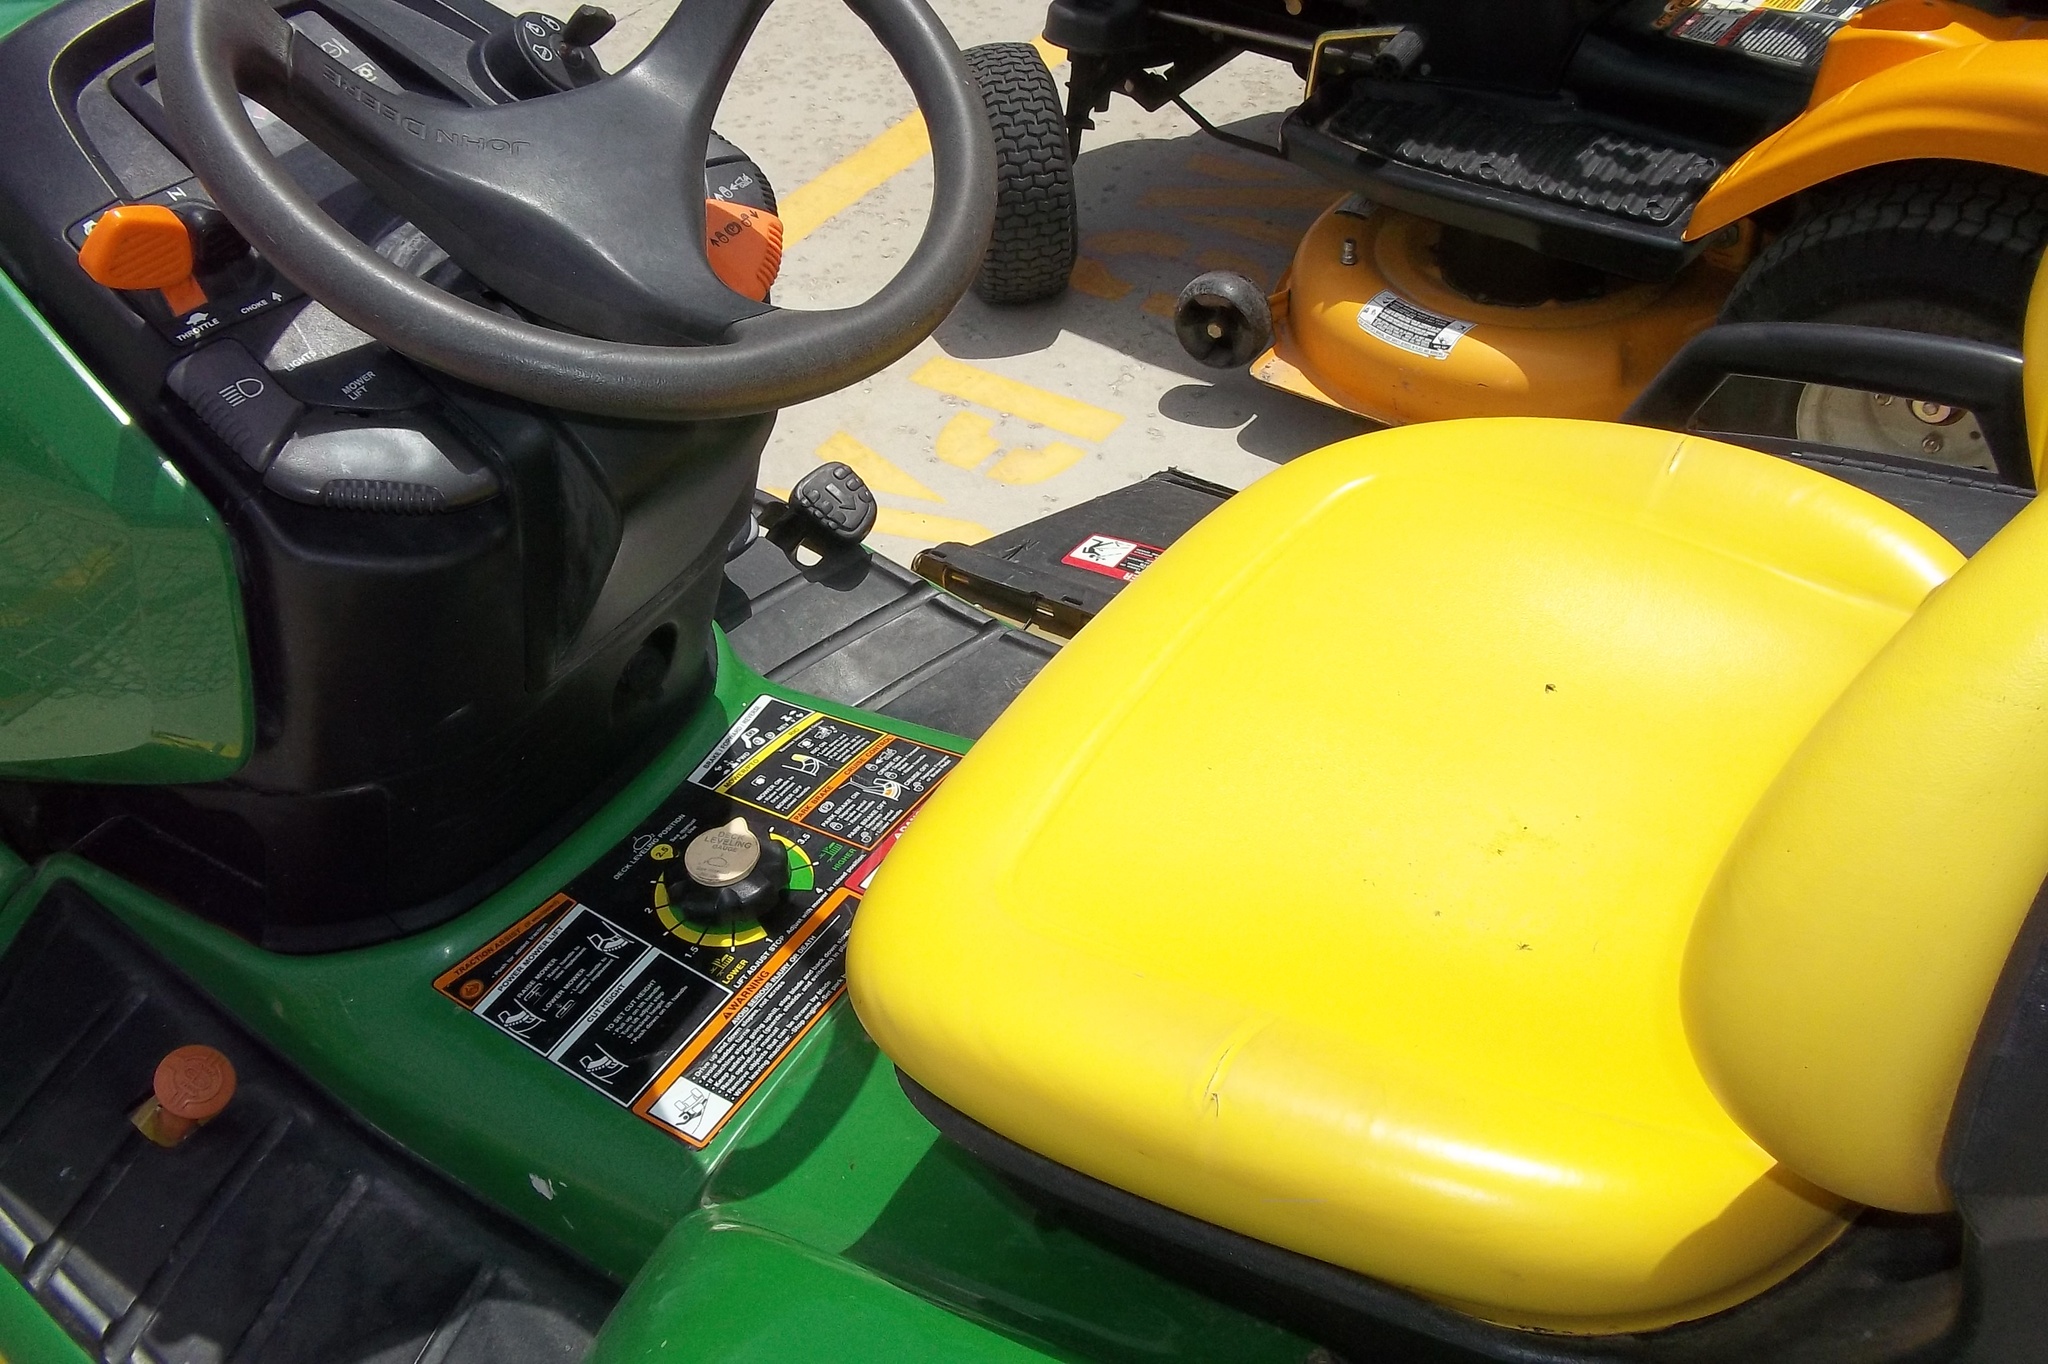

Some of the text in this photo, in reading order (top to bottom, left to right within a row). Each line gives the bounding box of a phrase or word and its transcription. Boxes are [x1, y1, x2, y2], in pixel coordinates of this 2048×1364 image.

[323, 65, 530, 155] JOHN DEERE
[240, 299, 269, 315] CHOKE
[176, 317, 220, 343] THROTTLE
[284, 350, 317, 373] LIGHTS
[341, 370, 377, 396] MOWER
[348, 384, 369, 401] LIFT
[702, 751, 721, 768] BRAKE
[735, 751, 751, 762] FWD
[842, 757, 867, 775] CRUISE
[864, 735, 894, 757] CONTROL
[755, 784, 776, 801] MOWER
[774, 784, 804, 809] MOWER OFF
[793, 785, 834, 820] PARK BRAKE
[819, 813, 837, 827] PARK
[833, 798, 853, 814] BRAKE
[846, 800, 888, 838] PARK BRAKE OFF
[612, 813, 686, 879] DECK LEVELING POSITION
[704, 835, 752, 849] LEVELING
[718, 831, 746, 841] DECK
[796, 833, 811, 844] 3.5
[655, 846, 669, 857] 2.5
[831, 848, 856, 870] HIGHER
[815, 886, 824, 894] 4
[453, 927, 522, 975] TRACTION ASSIST
[496, 966, 524, 991] POWER
[522, 940, 549, 966] MOWER
[547, 925, 564, 940] LIFT
[684, 945, 699, 958] 1.5
[732, 935, 786, 988] LIFT ADJUST STOP
[516, 957, 558, 998] RAISE MOWER
[721, 958, 748, 984] LOWER
[730, 935, 816, 1024] AVOID SERIOUS INJURY OR DEATH
[541, 967, 586, 1011] LOWER MOWER
[727, 969, 770, 1011] WARNING
[585, 982, 626, 1023] CUT HEIGHT
[604, 978, 657, 1031] TO SET CUT HEIGHT
[693, 1060, 711, 1077] Drive
[707, 1052, 719, 1062] up
[725, 1026, 743, 1043] down
[699, 1063, 718, 1080] Avoid
